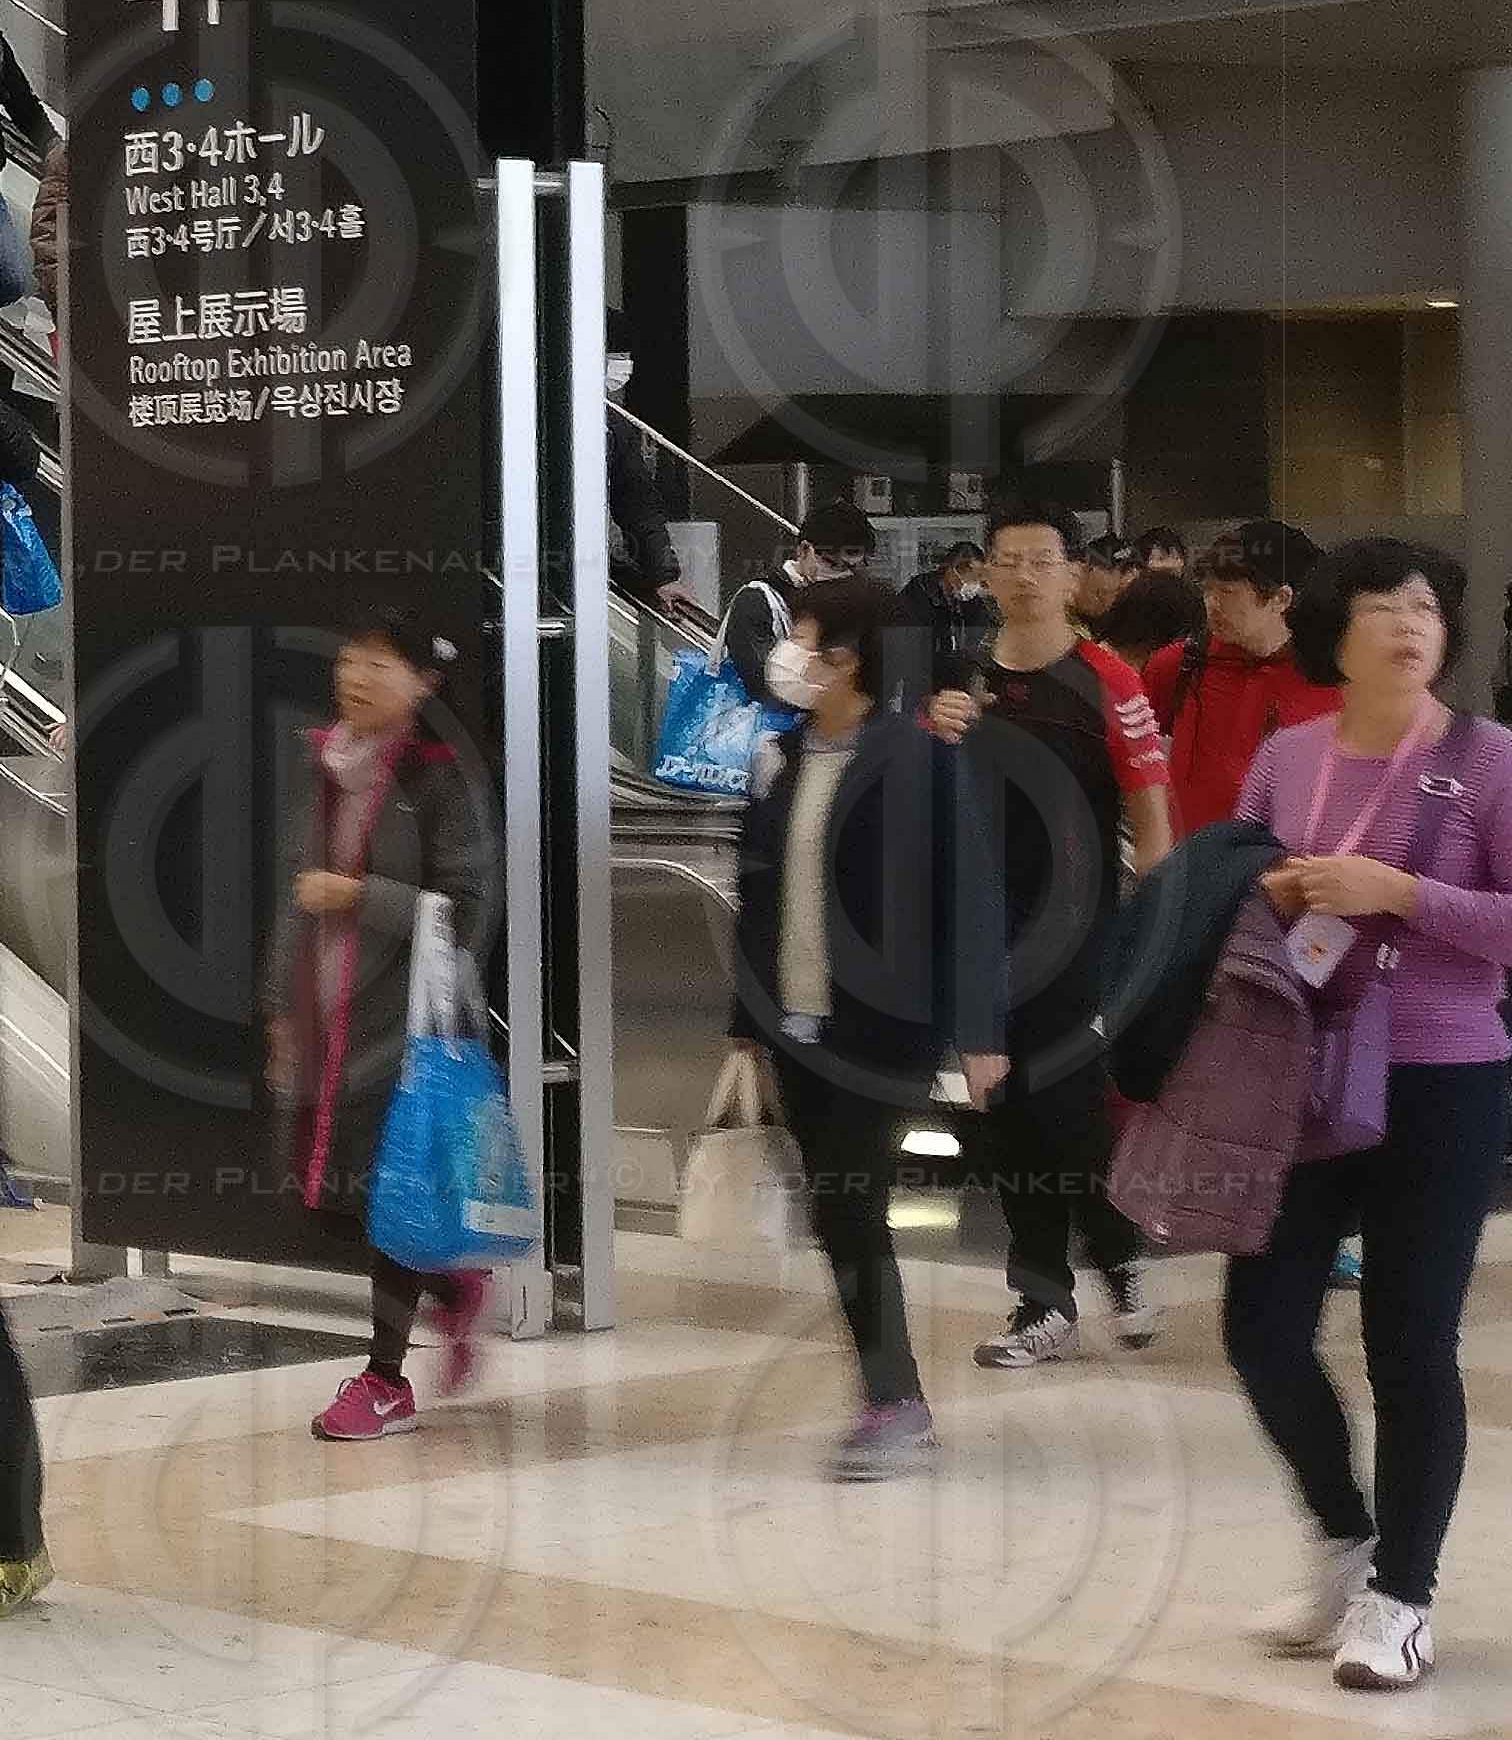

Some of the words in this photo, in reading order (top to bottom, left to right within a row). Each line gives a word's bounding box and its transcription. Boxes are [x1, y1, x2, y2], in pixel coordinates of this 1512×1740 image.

[124, 182, 185, 217] West
[190, 175, 238, 209] Hall
[126, 286, 308, 345] 屋上展示場
[129, 349, 220, 387] Rooftop
[227, 340, 348, 381] Exhibition
[355, 337, 414, 369] Area
